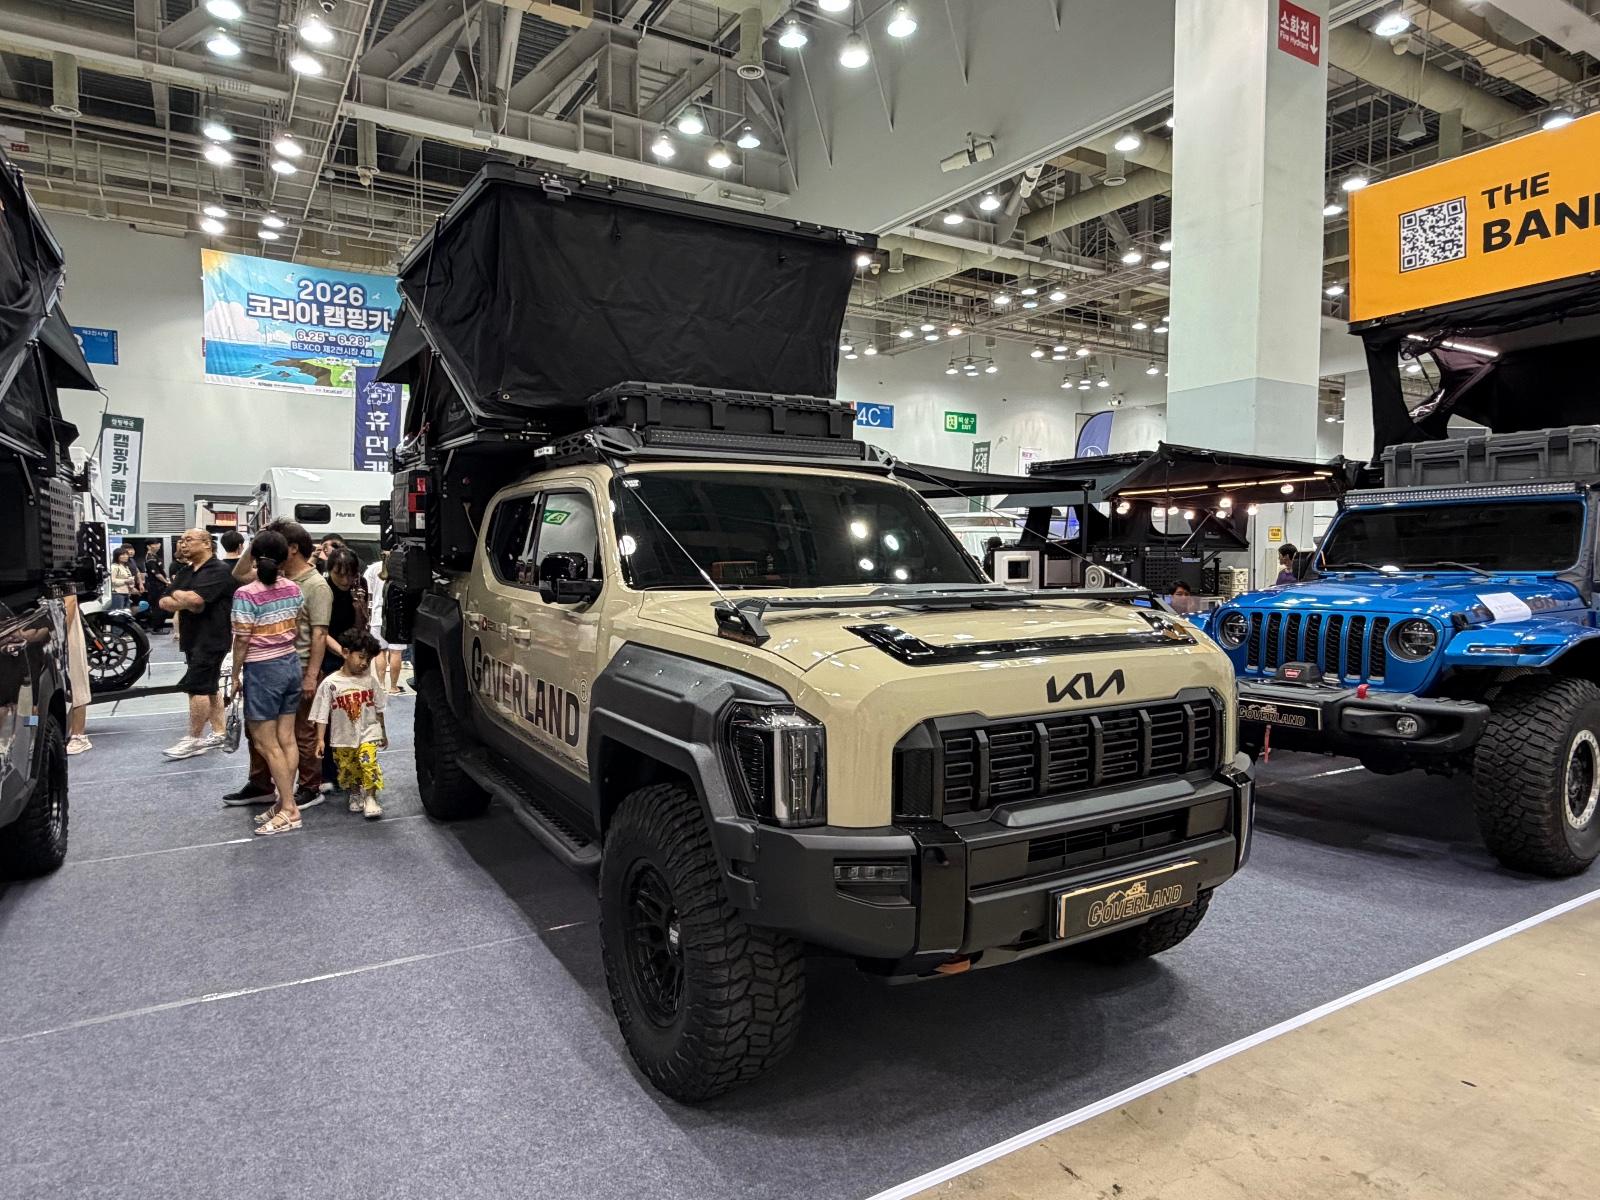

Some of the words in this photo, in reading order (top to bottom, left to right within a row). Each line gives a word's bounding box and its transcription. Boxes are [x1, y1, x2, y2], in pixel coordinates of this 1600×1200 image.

[1280, 10, 1309, 41] 소화전
[1481, 172, 1549, 210] THE
[299, 280, 364, 307] 2026
[248, 294, 320, 325] 코리아
[323, 305, 394, 332] 캠핑카
[292, 342, 320, 352] BEXCO
[857, 407, 881, 426] 4C
[112, 433, 129, 475] 캠핑카
[109, 478, 127, 522] 플래너
[471, 635, 580, 748] GOVERLAND
[1046, 668, 1125, 703] KIA
[1087, 884, 1183, 928] GOVERLAND
